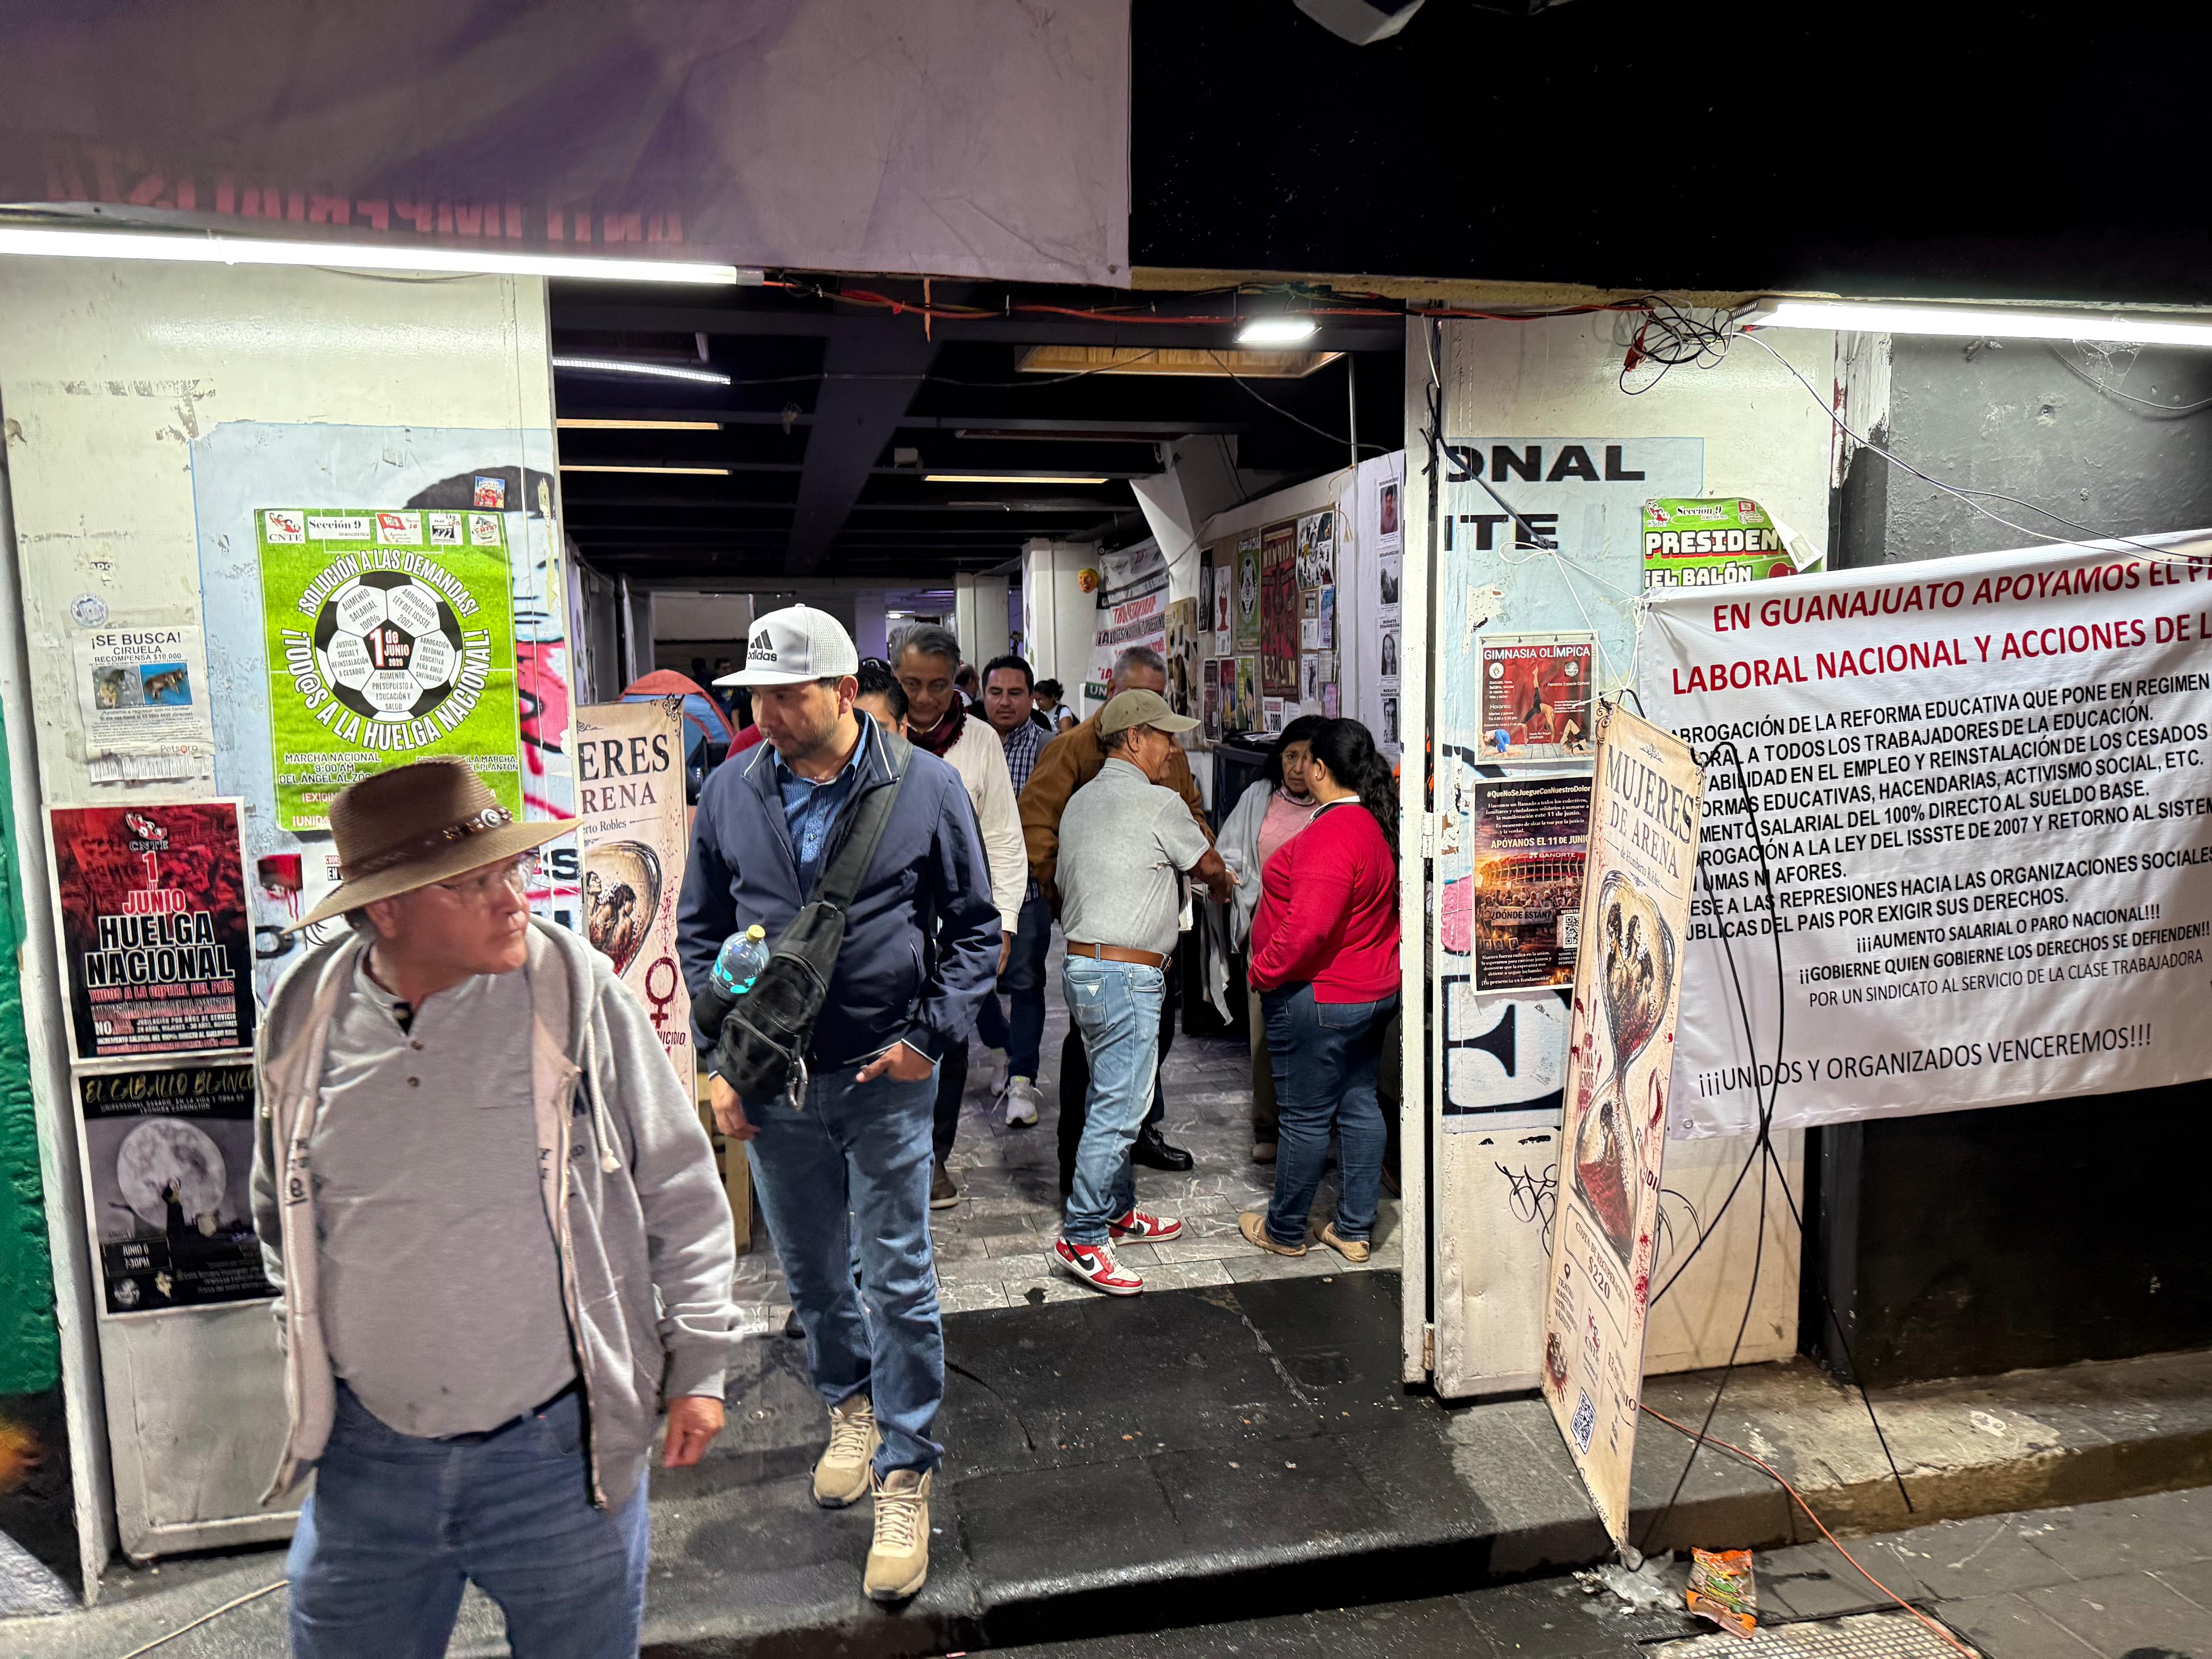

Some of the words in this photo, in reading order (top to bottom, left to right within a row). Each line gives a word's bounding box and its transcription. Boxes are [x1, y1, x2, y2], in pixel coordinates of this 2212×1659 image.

[1445, 446, 1645, 482] ONAL
[1677, 506, 1712, 516] Sección
[1715, 505, 1722, 514] 9
[309, 519, 350, 529] Sección
[354, 520, 361, 529] 9
[1645, 528, 1786, 558] PRESIDEN
[298, 554, 361, 619] ¡SOLUCIÓN
[360, 550, 373, 572] A
[373, 548, 401, 569] LAS
[404, 551, 481, 619] DEMANDAS!
[1682, 561, 1753, 586] BALÓN
[342, 588, 370, 611] AUMENTO
[401, 589, 437, 619] ABROGACIÓN
[1714, 602, 1750, 632] EN
[1761, 581, 1964, 626] GUANAJUATO
[1972, 562, 2140, 605] APOYAMOS
[2150, 558, 2180, 586] EL
[349, 600, 378, 622] SALARIAL
[360, 614, 381, 631] 100%
[392, 595, 404, 606] LEY
[402, 601, 415, 615] DEL
[411, 609, 431, 629] ISSSTE
[397, 614, 414, 629] 2007
[91, 634, 116, 649] ¡SE
[122, 632, 181, 645] BUSCA!
[113, 646, 162, 655] CIRUELA
[370, 627, 385, 667] 1
[385, 630, 399, 644] de
[384, 644, 410, 657] JUNIO
[1484, 648, 1537, 660] GIMNASIA
[1539, 645, 1590, 658] OLÍMPICA
[95, 654, 152, 663] RECOMPENSA
[748, 649, 777, 661] adidas
[1673, 656, 1808, 695] LABORAL
[1816, 639, 1967, 680] NACIONAL
[1974, 635, 1991, 663] Y
[2001, 619, 2146, 660] ACCIONES
[2156, 614, 2190, 643] DE
[281, 627, 330, 709] ¡TOD@S
[315, 700, 340, 726] A
[332, 709, 362, 743] LA
[362, 715, 443, 751] HUELGA
[433, 629, 491, 732] NACIONAL!
[1789, 716, 1811, 734] DE
[1816, 714, 1837, 731] LA
[1841, 704, 1922, 728] REFORMA
[1925, 693, 2020, 719] EDUCATIVA
[2023, 690, 2057, 709] QUE
[2063, 684, 2106, 705] PONE
[2112, 681, 2131, 699] EN
[2136, 673, 2209, 696] REGIMEN
[1748, 747, 1759, 764] A
[1764, 740, 1825, 761] TODOS
[1829, 736, 1860, 755] LOS
[1864, 721, 1999, 751] TRABAJADORES
[2002, 718, 2023, 736] DE
[2028, 716, 2049, 733] LA
[2054, 700, 2153, 731] EDUCACIÓN.
[285, 753, 329, 763] MARCHA
[330, 752, 381, 762] NACIONAL
[481, 755, 518, 764] MARCHA,
[1791, 766, 1813, 784] EN
[1819, 764, 1838, 781] EL
[1844, 755, 1909, 778] EMPLEO
[1915, 753, 1925, 770] Y
[1930, 735, 2060, 768] REINSTALACIÓN
[2065, 736, 2085, 754] DE
[2091, 732, 2122, 751] LOS
[2126, 723, 2207, 747] CESADOS
[280, 775, 298, 784] DEL
[301, 772, 334, 783] ÁNGEL
[337, 773, 351, 783] AL
[315, 764, 337, 773] 9:00
[339, 763, 355, 772] AM
[1487, 785, 1591, 798] #QueNoSeJuegueConNuestroDolor
[1605, 744, 1694, 844] MUJERES
[600, 818, 626, 832] Robles
[1491, 836, 1534, 849] APÓYANOS
[1548, 837, 1557, 846] 11
[1610, 800, 1628, 836] DE
[1631, 818, 1679, 879] ARENA
[142, 850, 159, 882] 1
[122, 889, 186, 915] JUNIO
[1524, 909, 1552, 919] ESTÁN?
[98, 911, 216, 951] HUELGA
[1949, 921, 2013, 941] SALARIAL
[2016, 919, 2026, 933] O
[2031, 915, 2068, 932] PARO
[2073, 904, 2160, 927] NACIONAL!!!
[1885, 955, 1929, 975] QUIEN
[1934, 947, 2004, 968] GOBIERNE
[2008, 944, 2032, 960] LOS
[2037, 936, 2108, 957] DERECHOS
[2113, 934, 2127, 948] SE
[2132, 921, 2210, 946] DEFIENDEN!!
[85, 944, 236, 987] NACIONAL
[94, 1020, 113, 1036] NO
[1808, 1059, 1820, 1081] Y
[1827, 1044, 1981, 1079] ORGANIZADOS
[1988, 1023, 2151, 1063] VENCEREMOS!!!
[111, 1073, 187, 1100] CABALLO
[1588, 1256, 1611, 1300] $220
